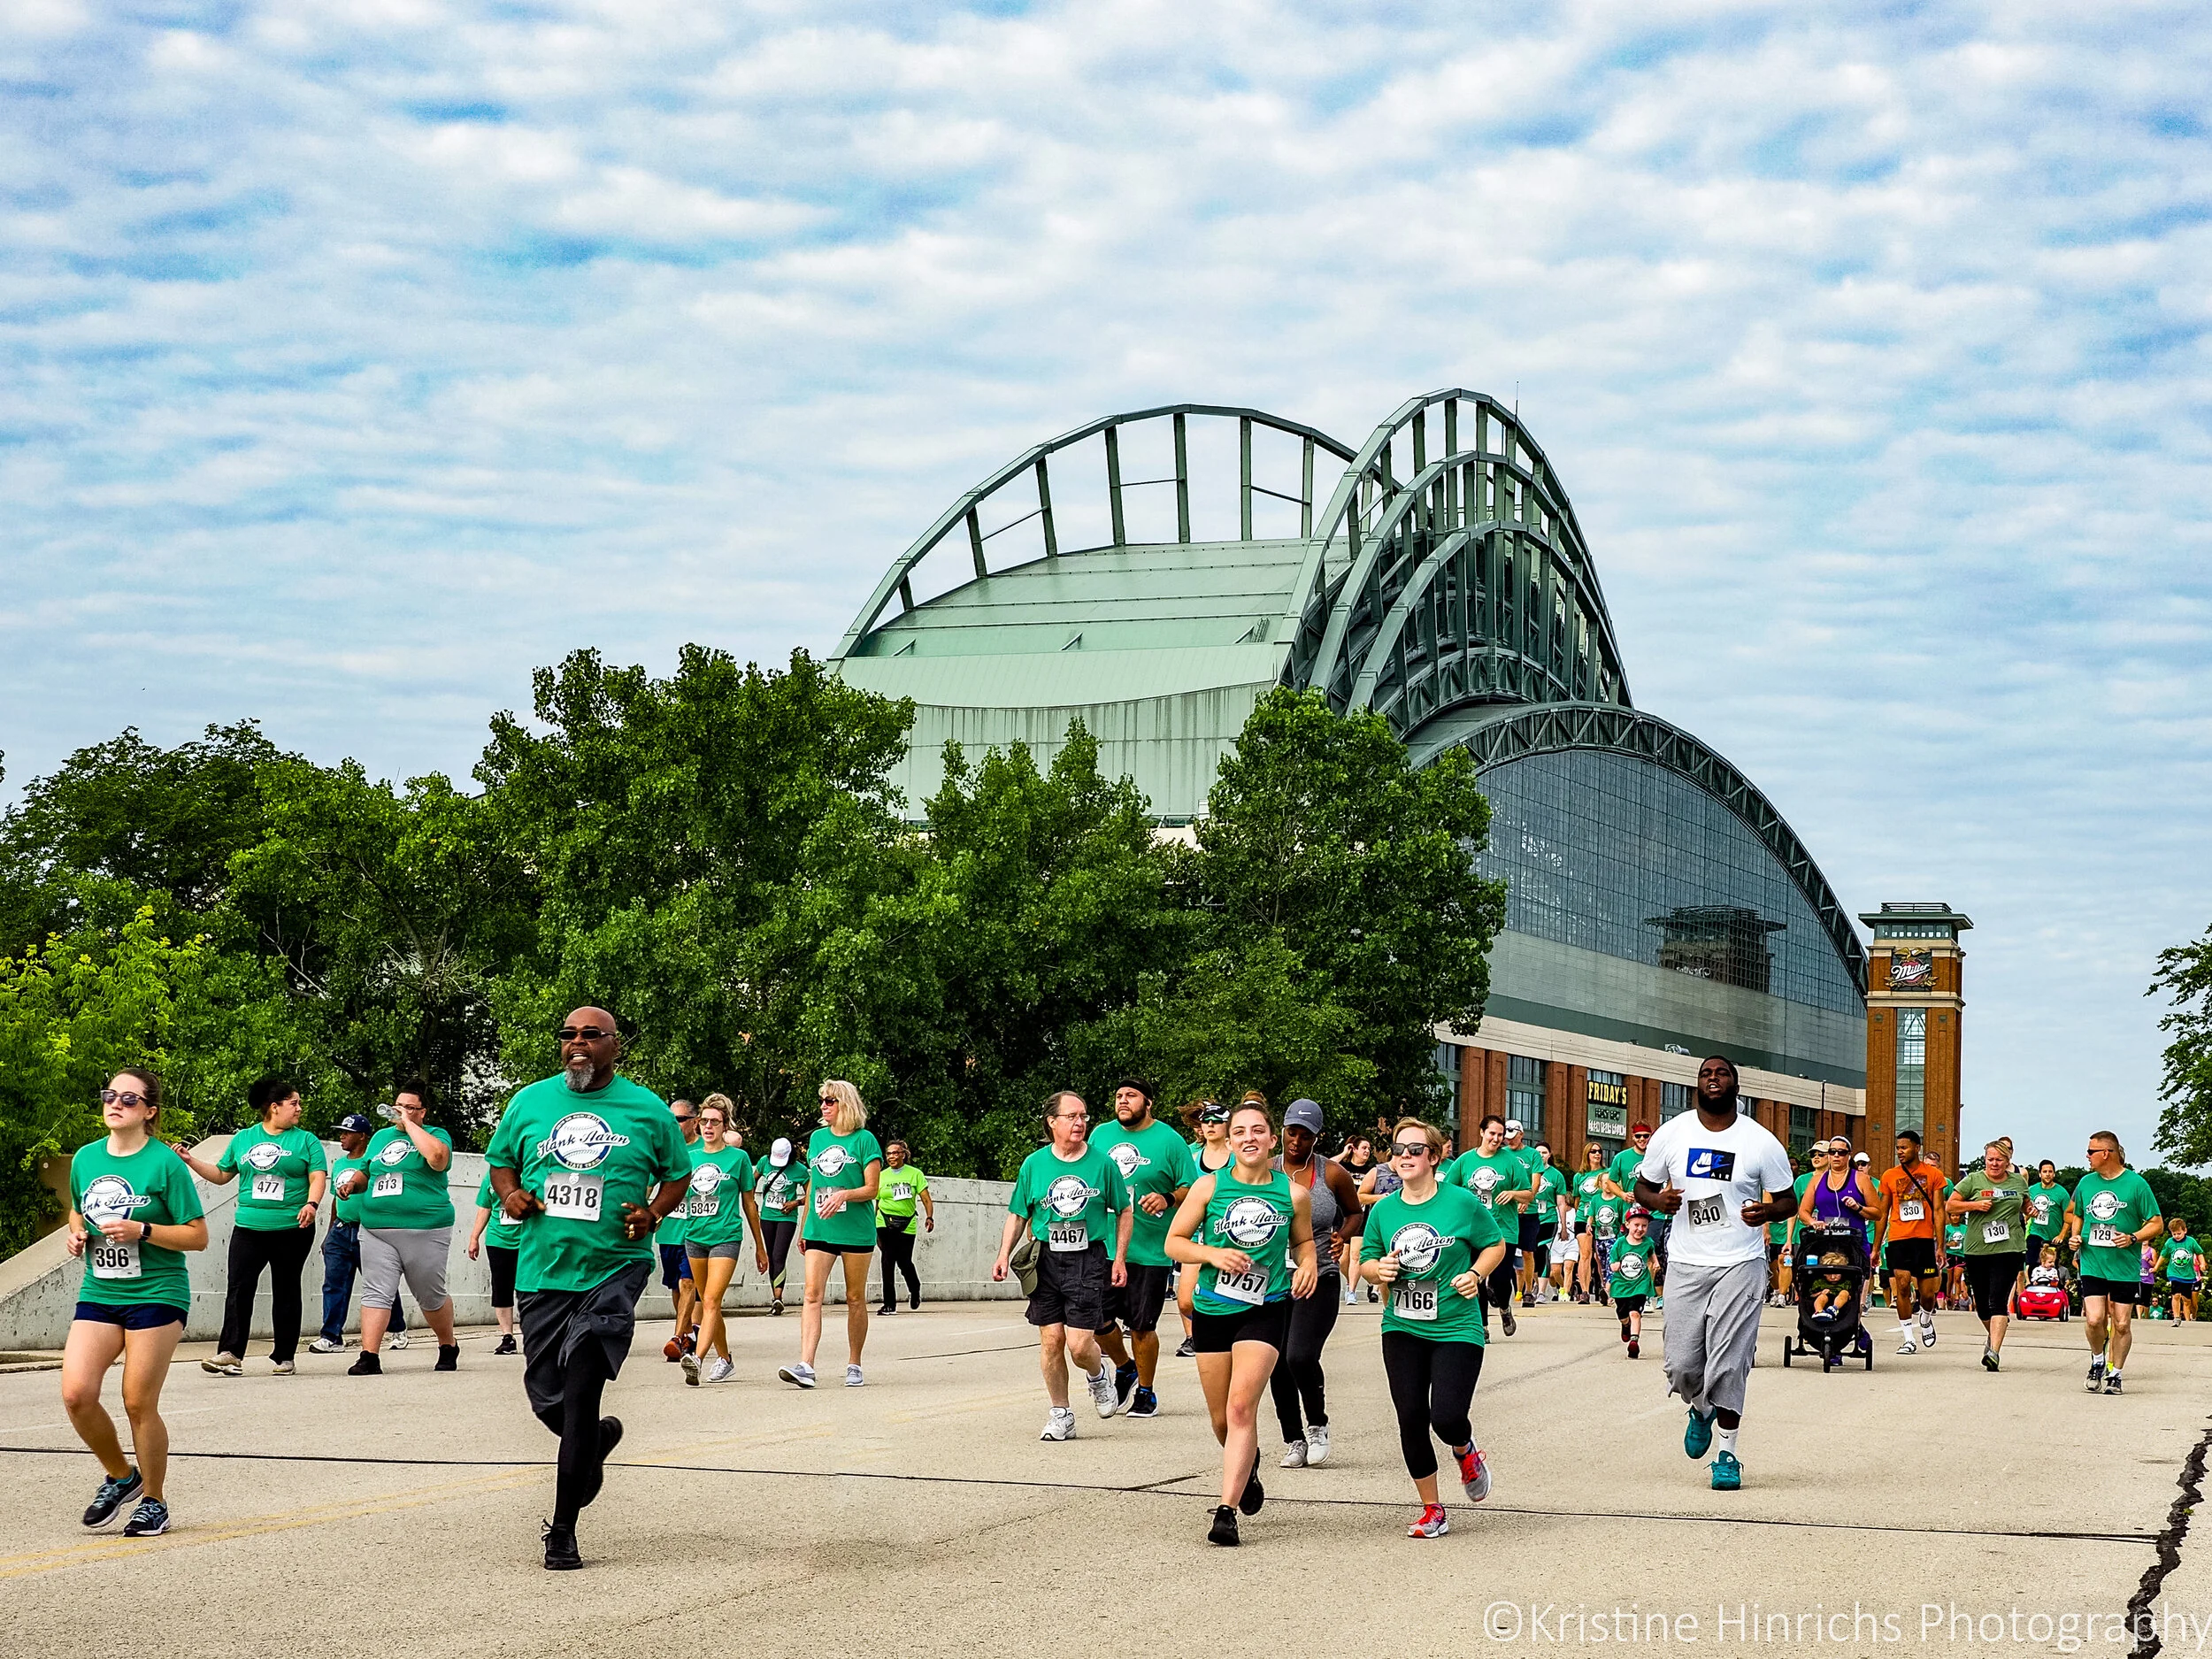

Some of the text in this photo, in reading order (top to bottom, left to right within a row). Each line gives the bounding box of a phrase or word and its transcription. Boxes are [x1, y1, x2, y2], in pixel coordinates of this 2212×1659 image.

[1891, 964, 1931, 980] Miller
[1588, 1081, 1627, 1105] FRIDAY'S
[538, 1130, 630, 1157] Hank Aaron
[1698, 1152, 1725, 1165] NIKE
[257, 1180, 280, 1194] 477
[377, 1178, 397, 1191] 613
[104, 1193, 151, 1208] Aaron
[547, 1185, 598, 1209] 4318
[1041, 1187, 1099, 1209] Hank Aaron
[691, 1202, 717, 1214] 5842
[1692, 1205, 1721, 1225] 340
[1903, 1206, 1919, 1216] 330
[1214, 1212, 1288, 1233] Hank Aaron
[1051, 1228, 1085, 1244] 4467
[1987, 1225, 2005, 1237] 130
[2093, 1229, 2111, 1240] 129
[1413, 1236, 1455, 1250] Aaron
[95, 1248, 129, 1268] 396
[1221, 1270, 1266, 1294] 5757
[1394, 1288, 1433, 1310] 7166
